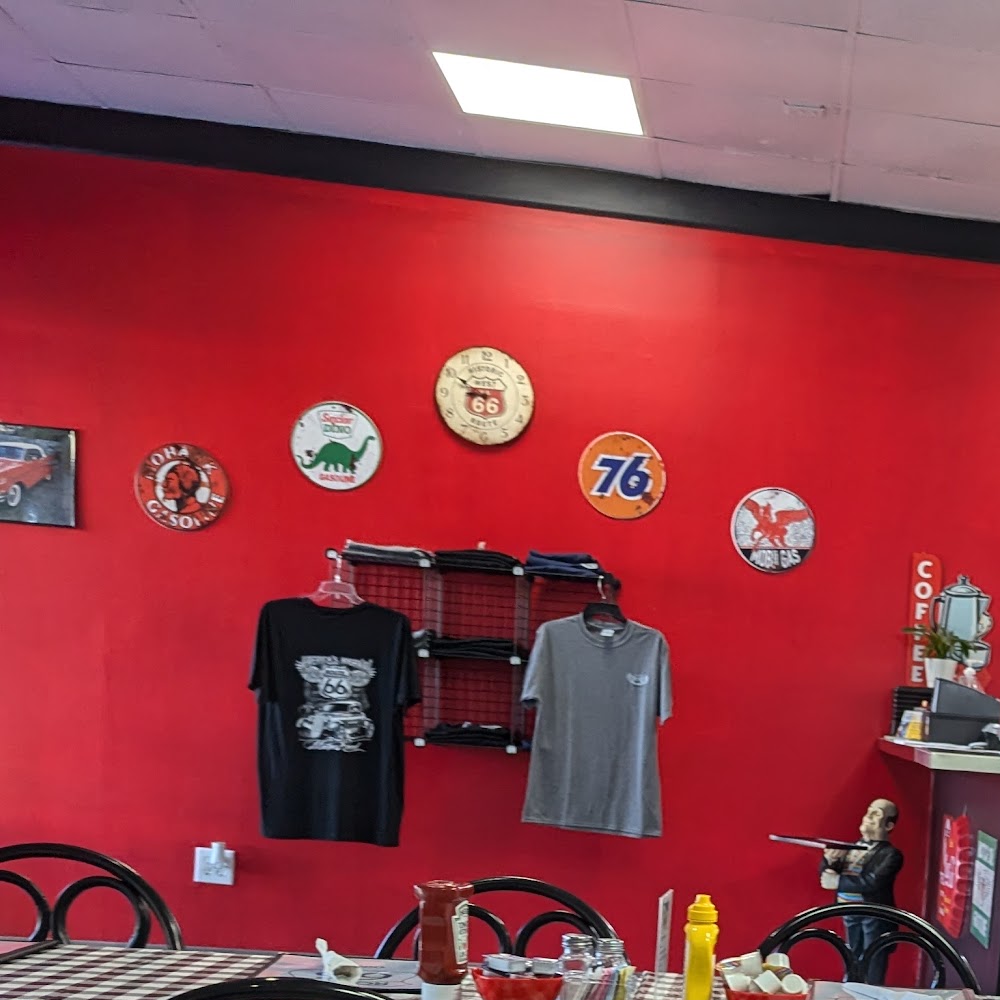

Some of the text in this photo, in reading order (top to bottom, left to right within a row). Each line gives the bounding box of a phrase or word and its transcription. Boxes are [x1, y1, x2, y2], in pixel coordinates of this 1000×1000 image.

[471, 395, 500, 415] 66
[590, 452, 653, 501] 76
[324, 679, 348, 695] 66
